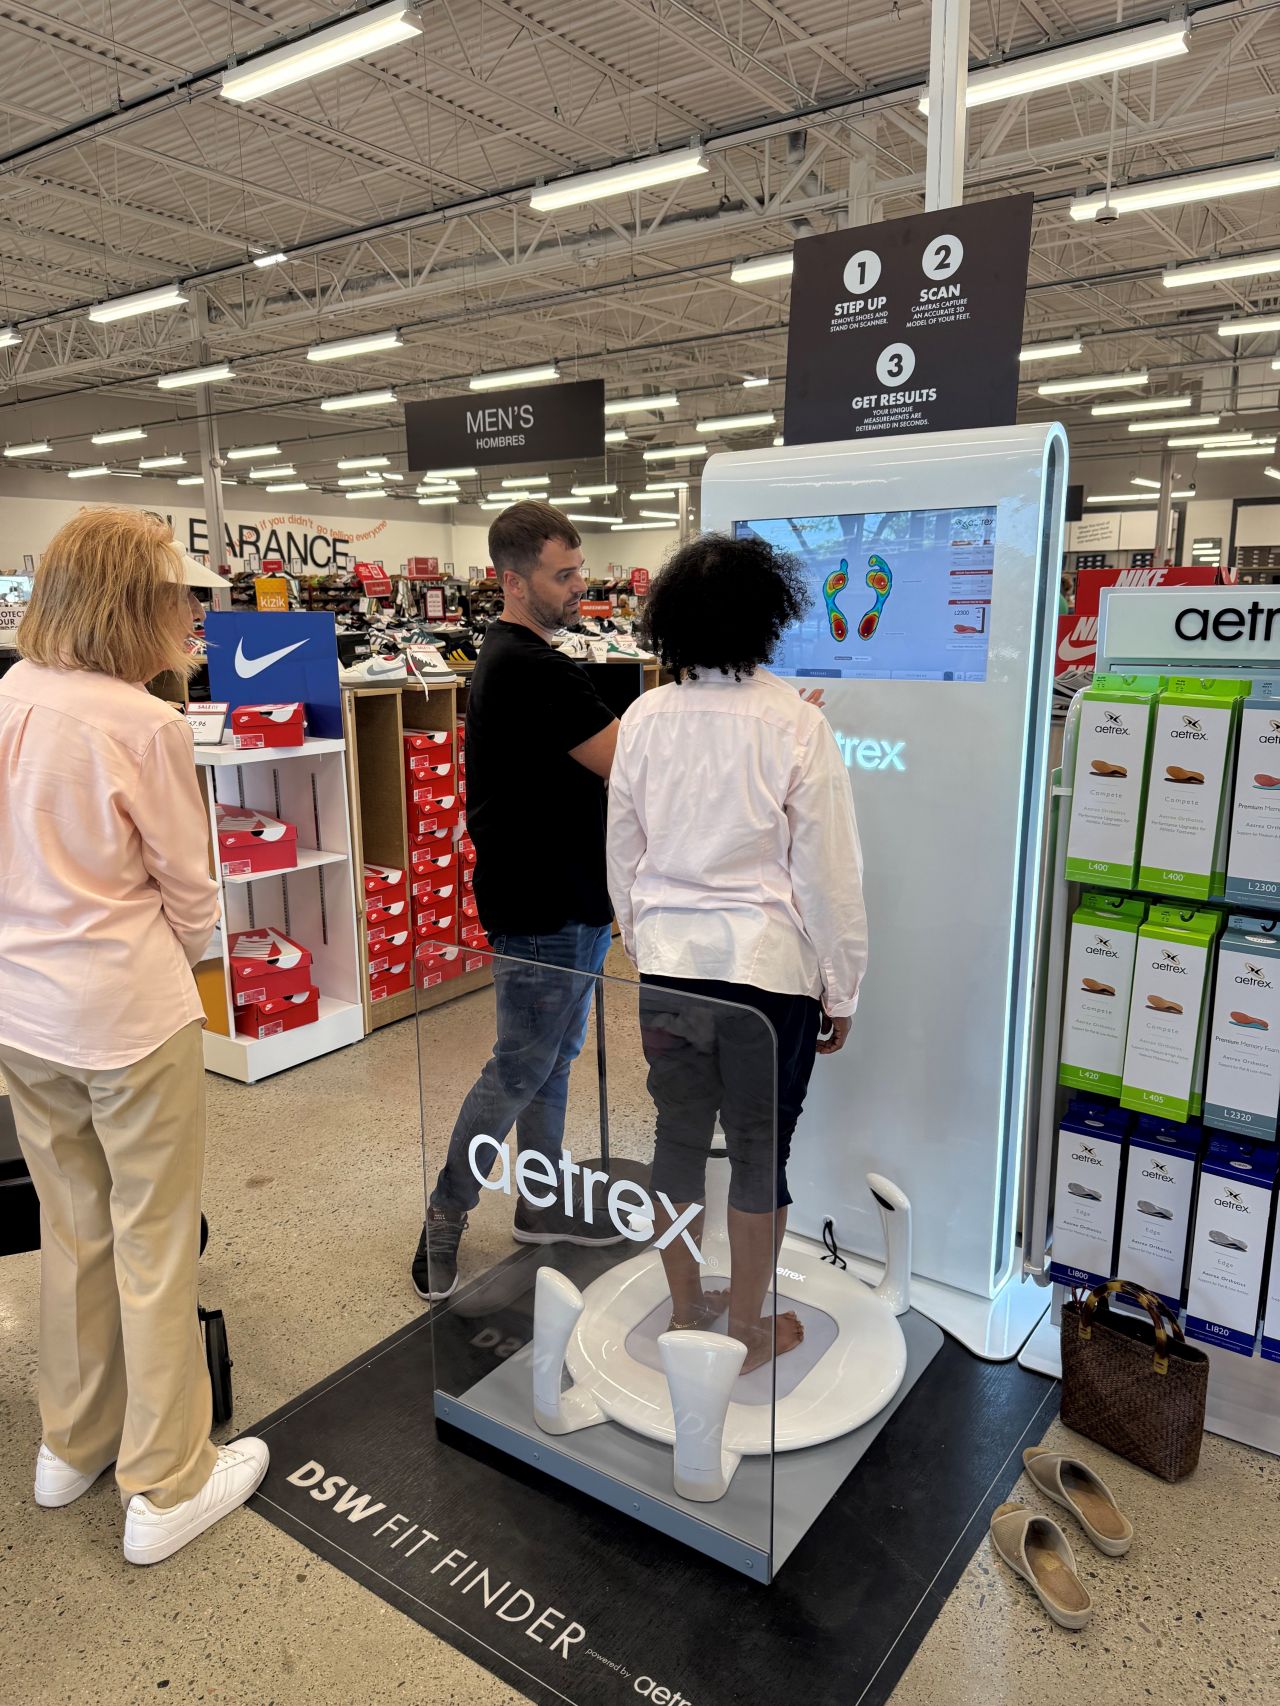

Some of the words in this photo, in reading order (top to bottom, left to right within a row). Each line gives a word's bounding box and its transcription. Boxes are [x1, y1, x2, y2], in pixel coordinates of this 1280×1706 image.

[933, 244, 952, 271] 2
[857, 261, 867, 285] 1
[919, 284, 961, 302] SCAN
[834, 300, 865, 316] STEP
[867, 296, 887, 311] UP
[911, 302, 940, 313] CAMERAS
[941, 298, 968, 307] CAPTURE
[831, 314, 854, 325] REMOVE
[855, 313, 874, 322] SHOES
[875, 311, 889, 319] AND
[906, 319, 927, 328] MODEL
[938, 315, 955, 324] YOUR
[956, 313, 971, 321] FEET.
[924, 309, 954, 318] ACCURATE
[830, 325, 848, 333] STAND
[860, 319, 889, 328] SCANNER.
[887, 353, 903, 378] 3
[852, 395, 877, 409] GET
[880, 388, 937, 406] RESULTS
[873, 408, 889, 416] YOUR
[890, 406, 913, 414] UNIQUE
[466, 404, 534, 434] MEN'S
[864, 414, 909, 424] MEASUREMENTS
[856, 424, 890, 432] DETERMINED
[476, 434, 526, 450] HOMBRES
[268, 515, 285, 528] you
[288, 514, 313, 529] didn't
[316, 524, 328, 535] go
[330, 528, 354, 543] telling
[355, 520, 388, 542] everyone
[260, 595, 286, 608] kizik
[1175, 601, 1280, 641] aetr
[1095, 725, 1131, 736] aetrex
[1171, 730, 1208, 741] aetrex
[835, 731, 906, 770] trex
[1238, 803, 1264, 811] Premium
[1089, 862, 1108, 872] L400
[1163, 872, 1183, 881] L400
[1085, 946, 1119, 959] aetrex
[1152, 961, 1188, 975] aetrex
[1234, 975, 1273, 989] aetrex
[1215, 1035, 1240, 1046] Premium
[1079, 1070, 1099, 1080] L420
[1143, 1093, 1164, 1103] L405
[1224, 1109, 1252, 1122] L2320
[1072, 1153, 1103, 1166] aetrex
[1141, 1169, 1176, 1184] aetrex
[468, 1133, 707, 1265] aetrex
[1214, 1197, 1251, 1214] aetrex
[776, 1267, 806, 1282] etrex
[286, 1460, 388, 1524] DSW
[372, 1513, 439, 1558] FIT
[430, 1548, 587, 1660] FINDER
[585, 1648, 622, 1671] powered
[620, 1666, 631, 1679] by
[633, 1675, 692, 1706] aetr
